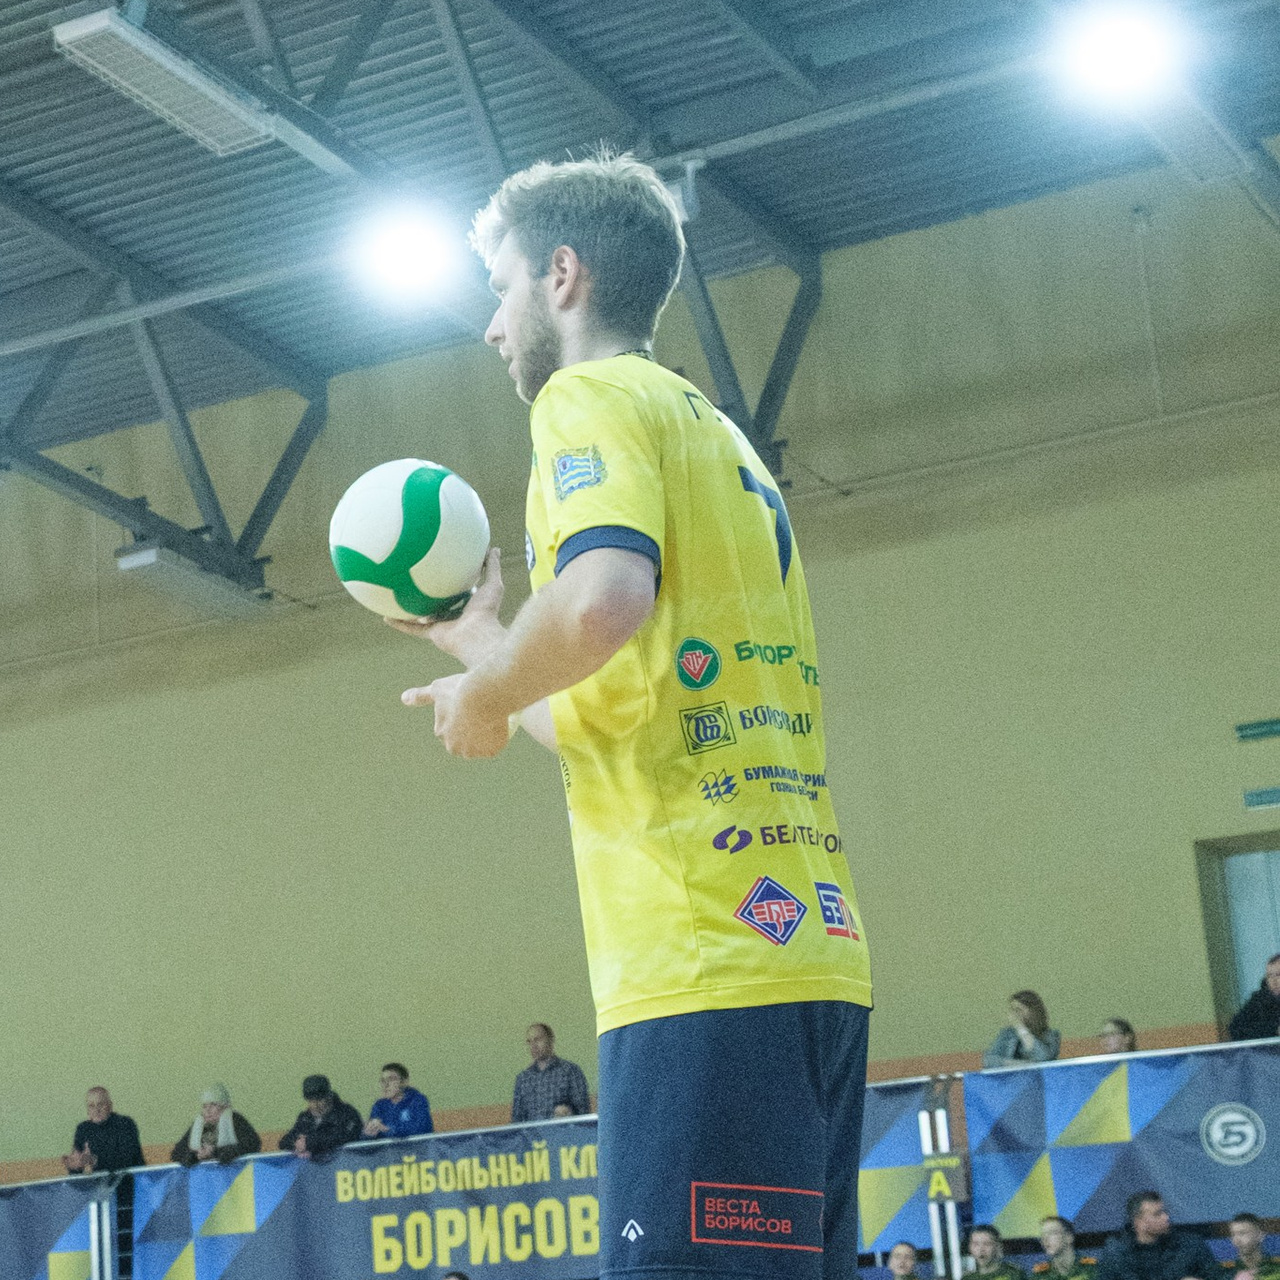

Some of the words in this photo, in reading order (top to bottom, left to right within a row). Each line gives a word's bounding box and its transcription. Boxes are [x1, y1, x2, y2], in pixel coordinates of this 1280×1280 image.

[737, 465, 792, 590] 7
[336, 1140, 550, 1203] ВОЛЕЙБОЛЬНЫЙ
[560, 1144, 598, 1180] КЛ
[372, 1194, 600, 1274] БОРИСОВ
[704, 1197, 761, 1215] ВЕСТА
[704, 1214, 793, 1235] БОРИСОВ
